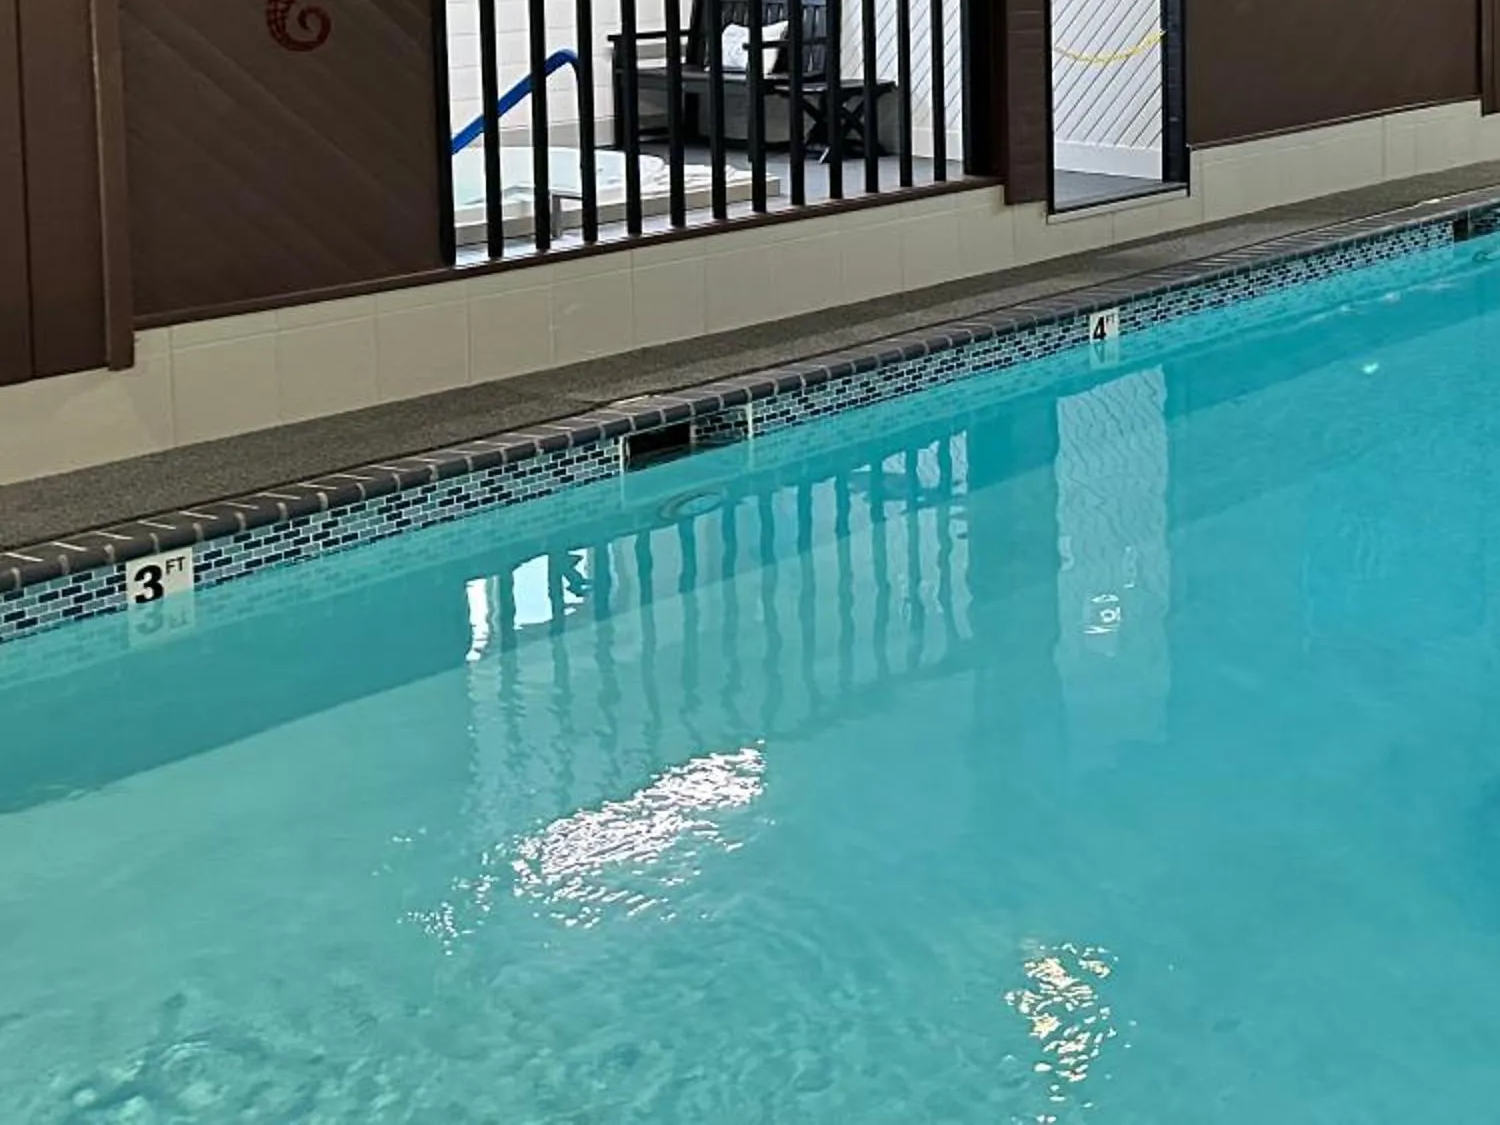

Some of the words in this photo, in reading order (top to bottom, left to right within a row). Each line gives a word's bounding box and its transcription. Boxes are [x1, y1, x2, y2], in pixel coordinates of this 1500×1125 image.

[1093, 316, 1107, 340] 4
[134, 564, 165, 604] 3
[165, 556, 186, 575] FT
